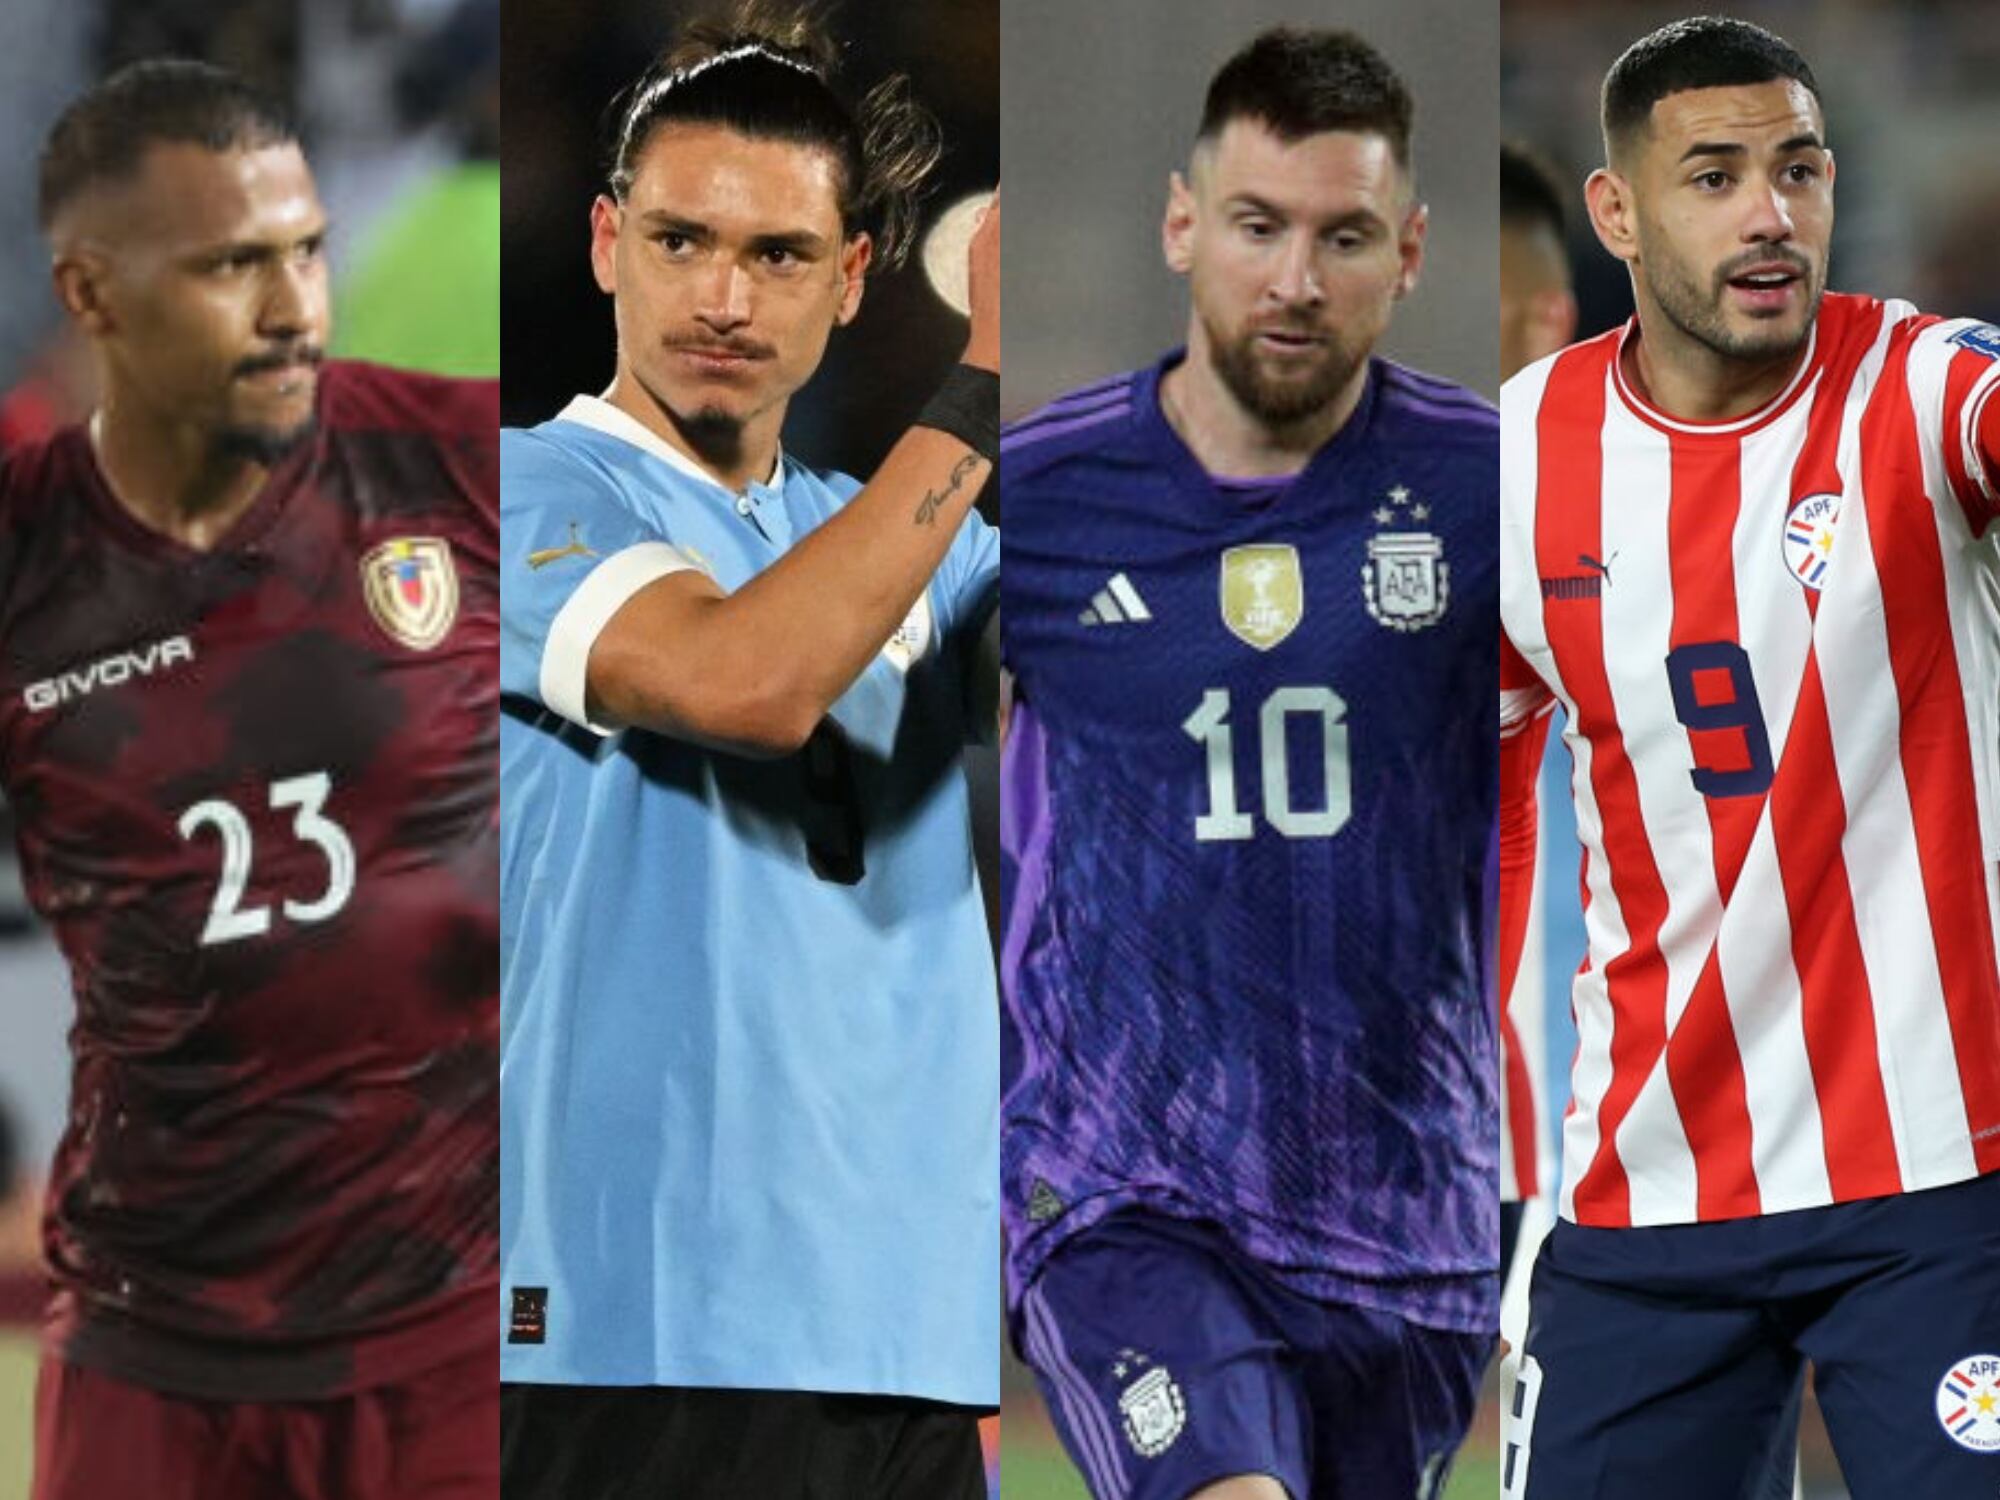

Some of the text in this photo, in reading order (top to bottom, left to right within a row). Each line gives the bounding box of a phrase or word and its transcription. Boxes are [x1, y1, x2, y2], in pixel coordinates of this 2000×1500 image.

[1804, 498, 1831, 520] APF
[1540, 575, 1602, 600] PUMA
[24, 635, 194, 712] GIVOVA
[1665, 640, 1775, 798] 9
[1181, 687, 1352, 840] 10
[177, 769, 356, 944] 23
[1968, 1360, 2000, 1376] APF
